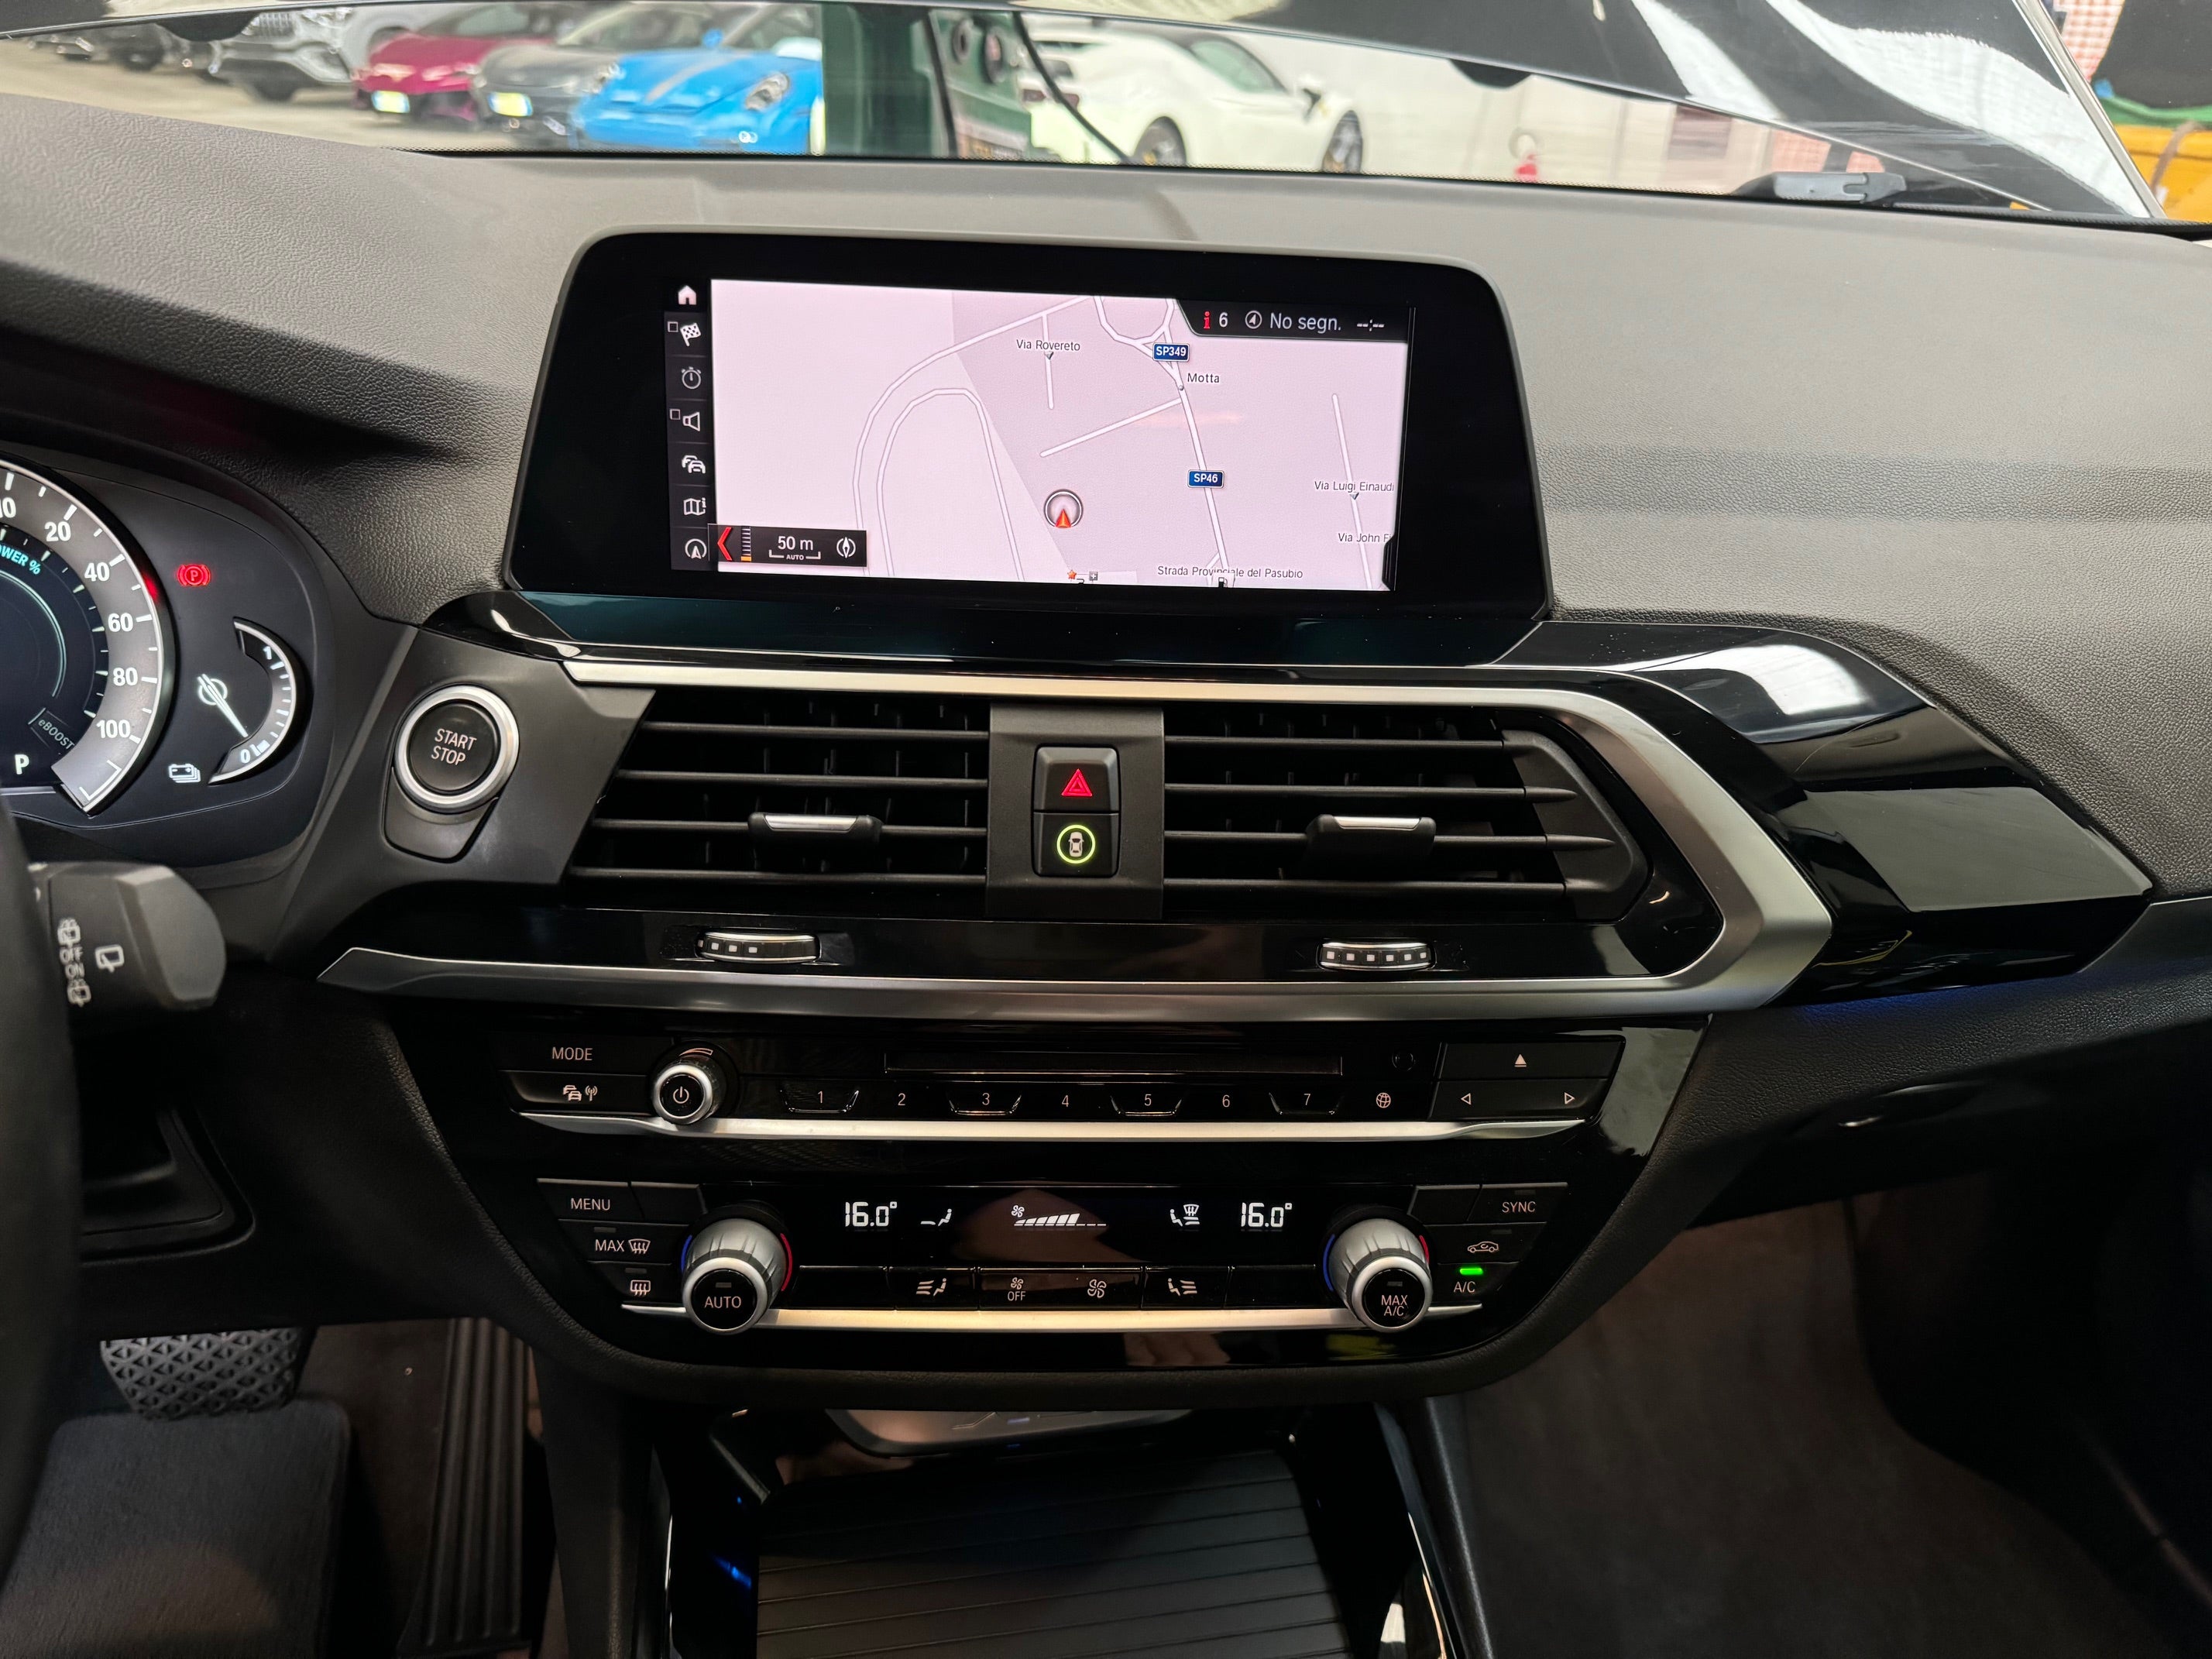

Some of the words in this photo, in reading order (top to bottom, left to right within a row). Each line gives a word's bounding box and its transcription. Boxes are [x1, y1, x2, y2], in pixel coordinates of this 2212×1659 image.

[1218, 312, 1228, 328] 6
[1269, 312, 1292, 330] No
[1298, 315, 1341, 334] segn.
[1016, 339, 1032, 350] Via
[1036, 341, 1080, 352] Rovereto
[1156, 345, 1187, 357] SP349
[1187, 373, 1220, 384] Motta
[1194, 473, 1218, 483] SP46
[1314, 480, 1329, 490] Via
[1333, 481, 1356, 493] Luigi
[44, 520, 71, 542] 20
[1338, 532, 1353, 542] Via
[1356, 533, 1380, 543] John
[778, 535, 796, 551] 50
[799, 539, 813, 551] m
[84, 562, 110, 582] 40
[1158, 565, 1188, 575] Strada
[1247, 568, 1262, 578] del
[1265, 568, 1304, 579] Pasubio
[108, 613, 133, 633] 60
[263, 645, 273, 660] 1
[112, 668, 138, 686] 80
[38, 719, 75, 750] eBOOST
[95, 719, 131, 739] 100
[434, 728, 477, 751] START
[240, 748, 251, 764] 0
[431, 745, 466, 765] STOP
[14, 754, 30, 775] P
[551, 1046, 593, 1062] MODE
[817, 1091, 824, 1104] 1
[897, 1093, 906, 1106] 2
[982, 1093, 991, 1105] 3
[1061, 1094, 1070, 1108] 4
[1143, 1094, 1152, 1107] 5
[1221, 1094, 1231, 1108] 6
[1304, 1093, 1311, 1106] 7
[570, 1197, 611, 1211] MENU
[1501, 1201, 1537, 1214] SYNC
[595, 1239, 625, 1253] MAX
[1453, 1281, 1476, 1293] A/C
[704, 1296, 742, 1309] AUTO
[1008, 1291, 1026, 1301] OFF
[1381, 1294, 1408, 1306] MAX
[1383, 1305, 1404, 1317] A/C
